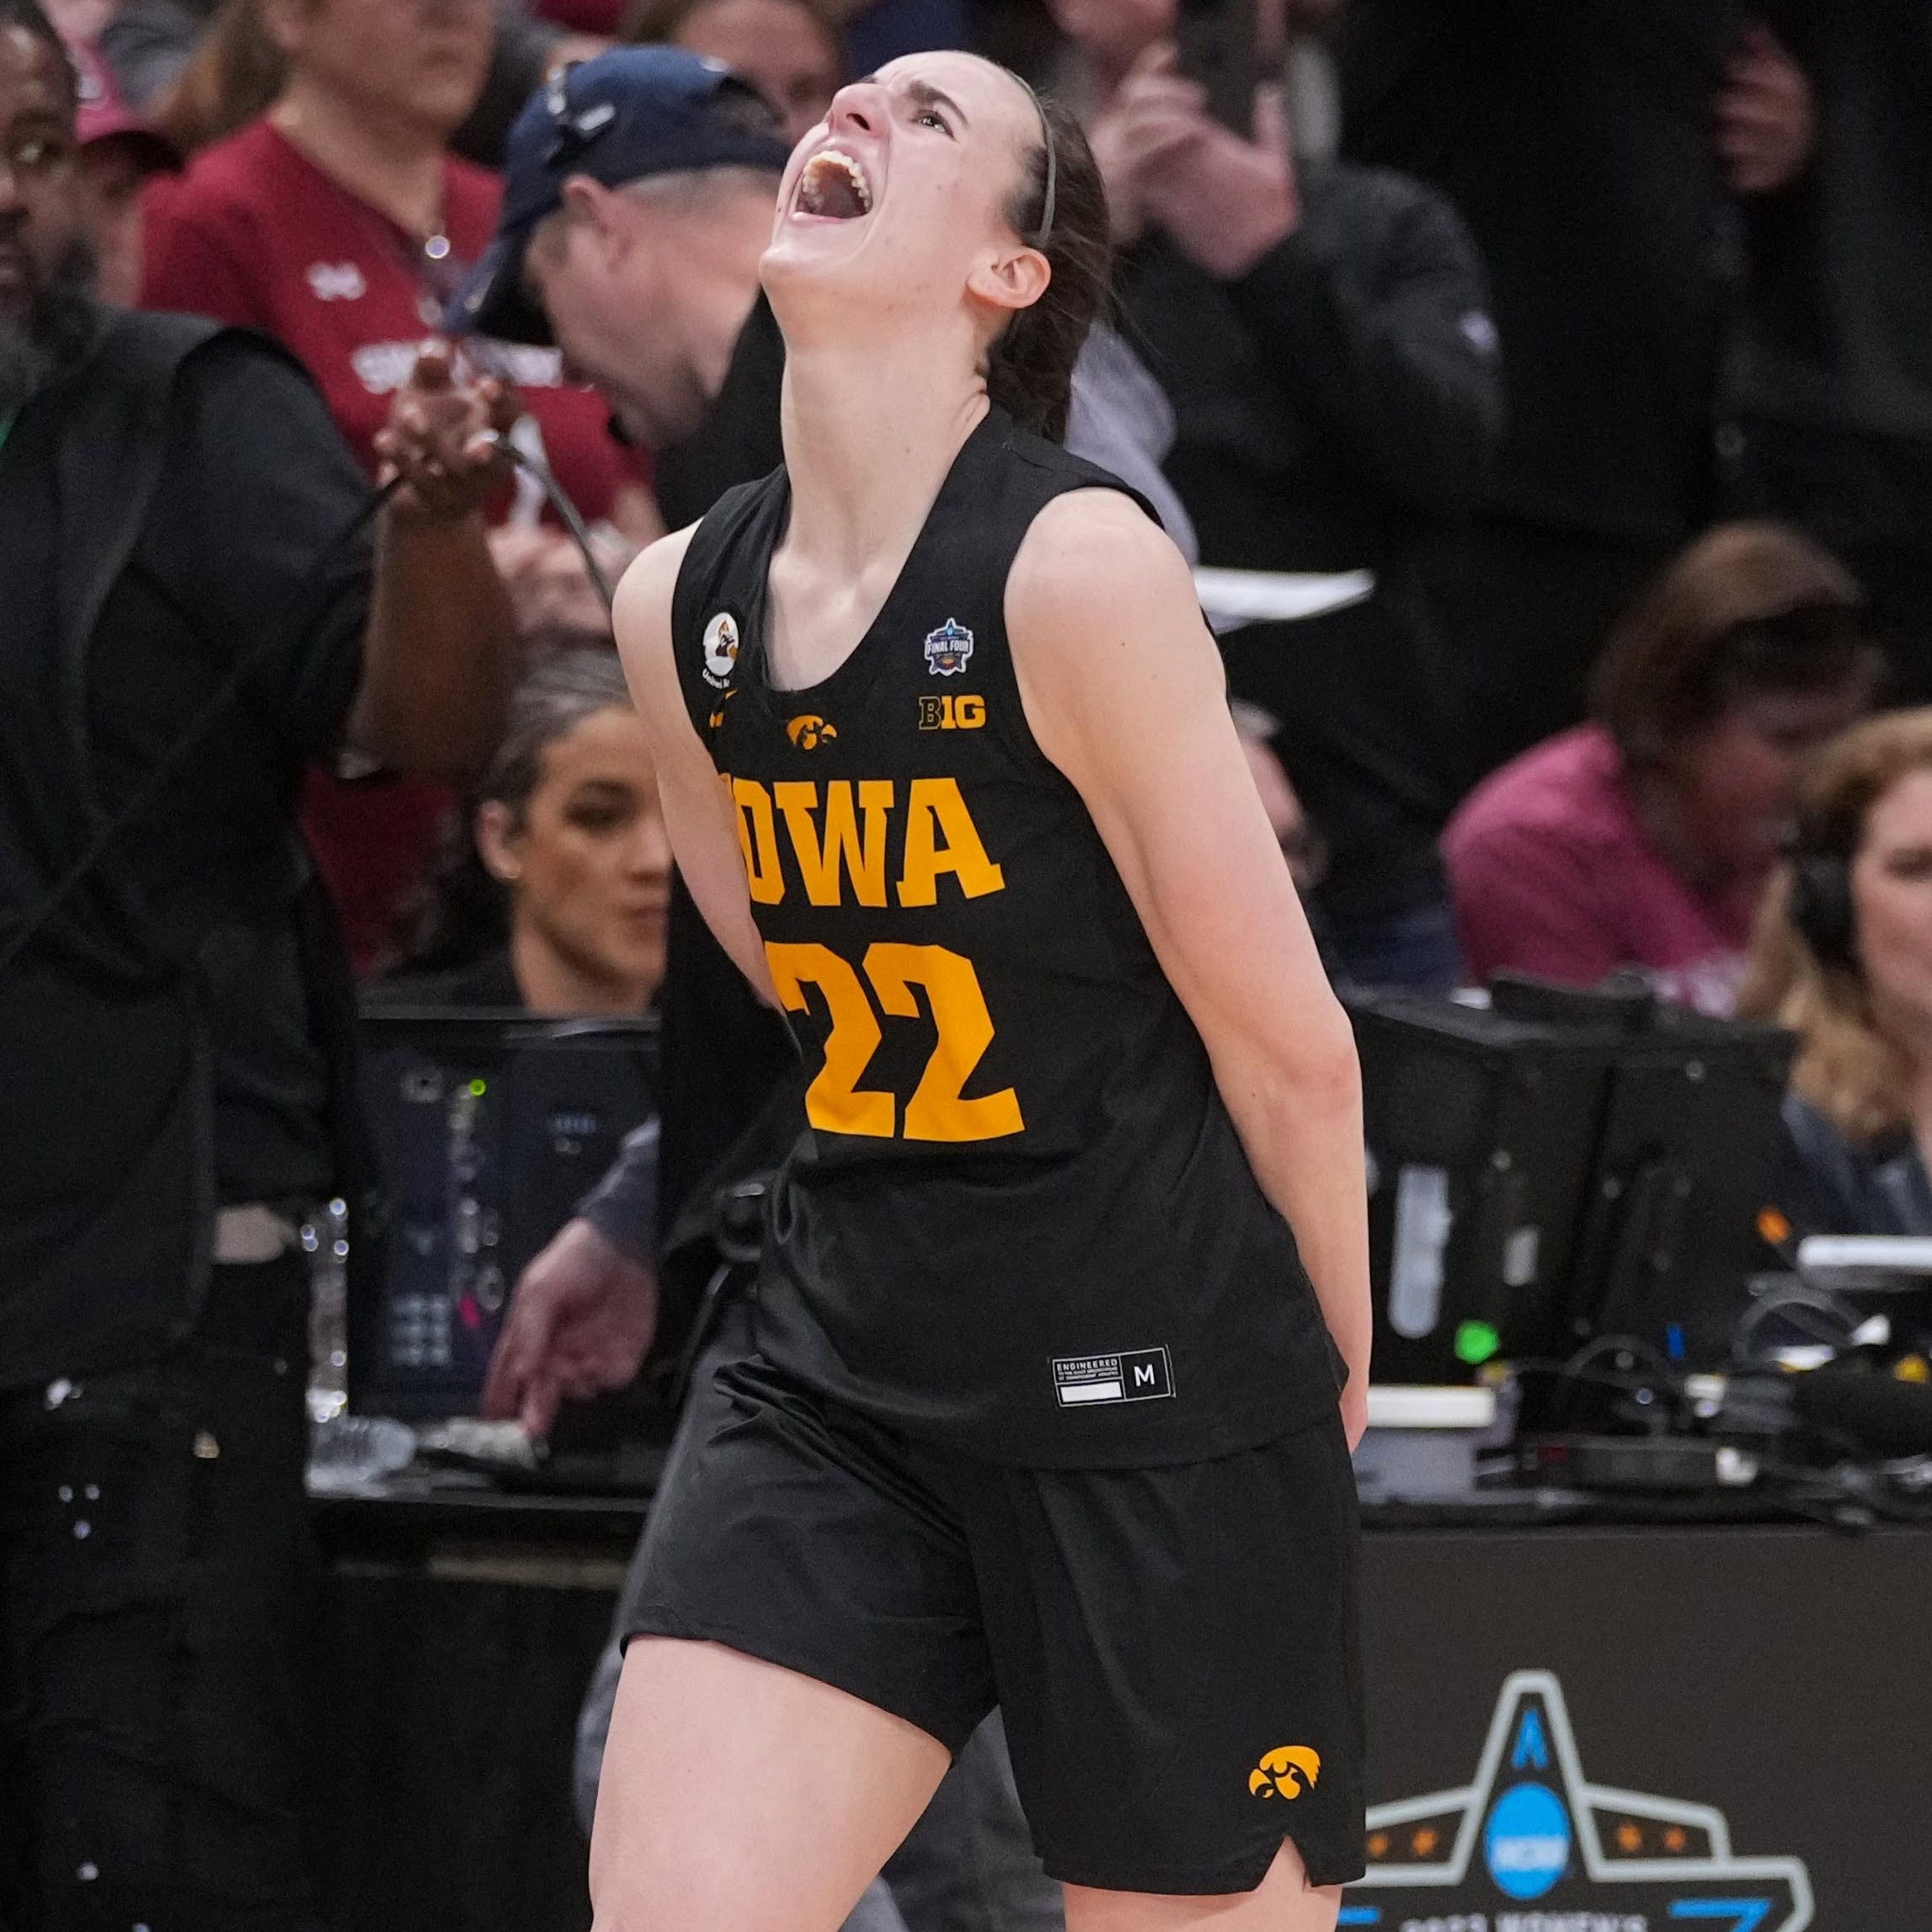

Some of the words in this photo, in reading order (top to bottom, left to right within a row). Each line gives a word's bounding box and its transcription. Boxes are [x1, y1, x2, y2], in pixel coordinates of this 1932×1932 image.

[926, 640, 948, 655] FINAL
[949, 639, 969, 653] FOUR
[718, 773, 1006, 909] OWA
[765, 942, 1026, 1143] 22
[1056, 1358, 1118, 1372] ENGINEERED
[1133, 1364, 1155, 1387] M
